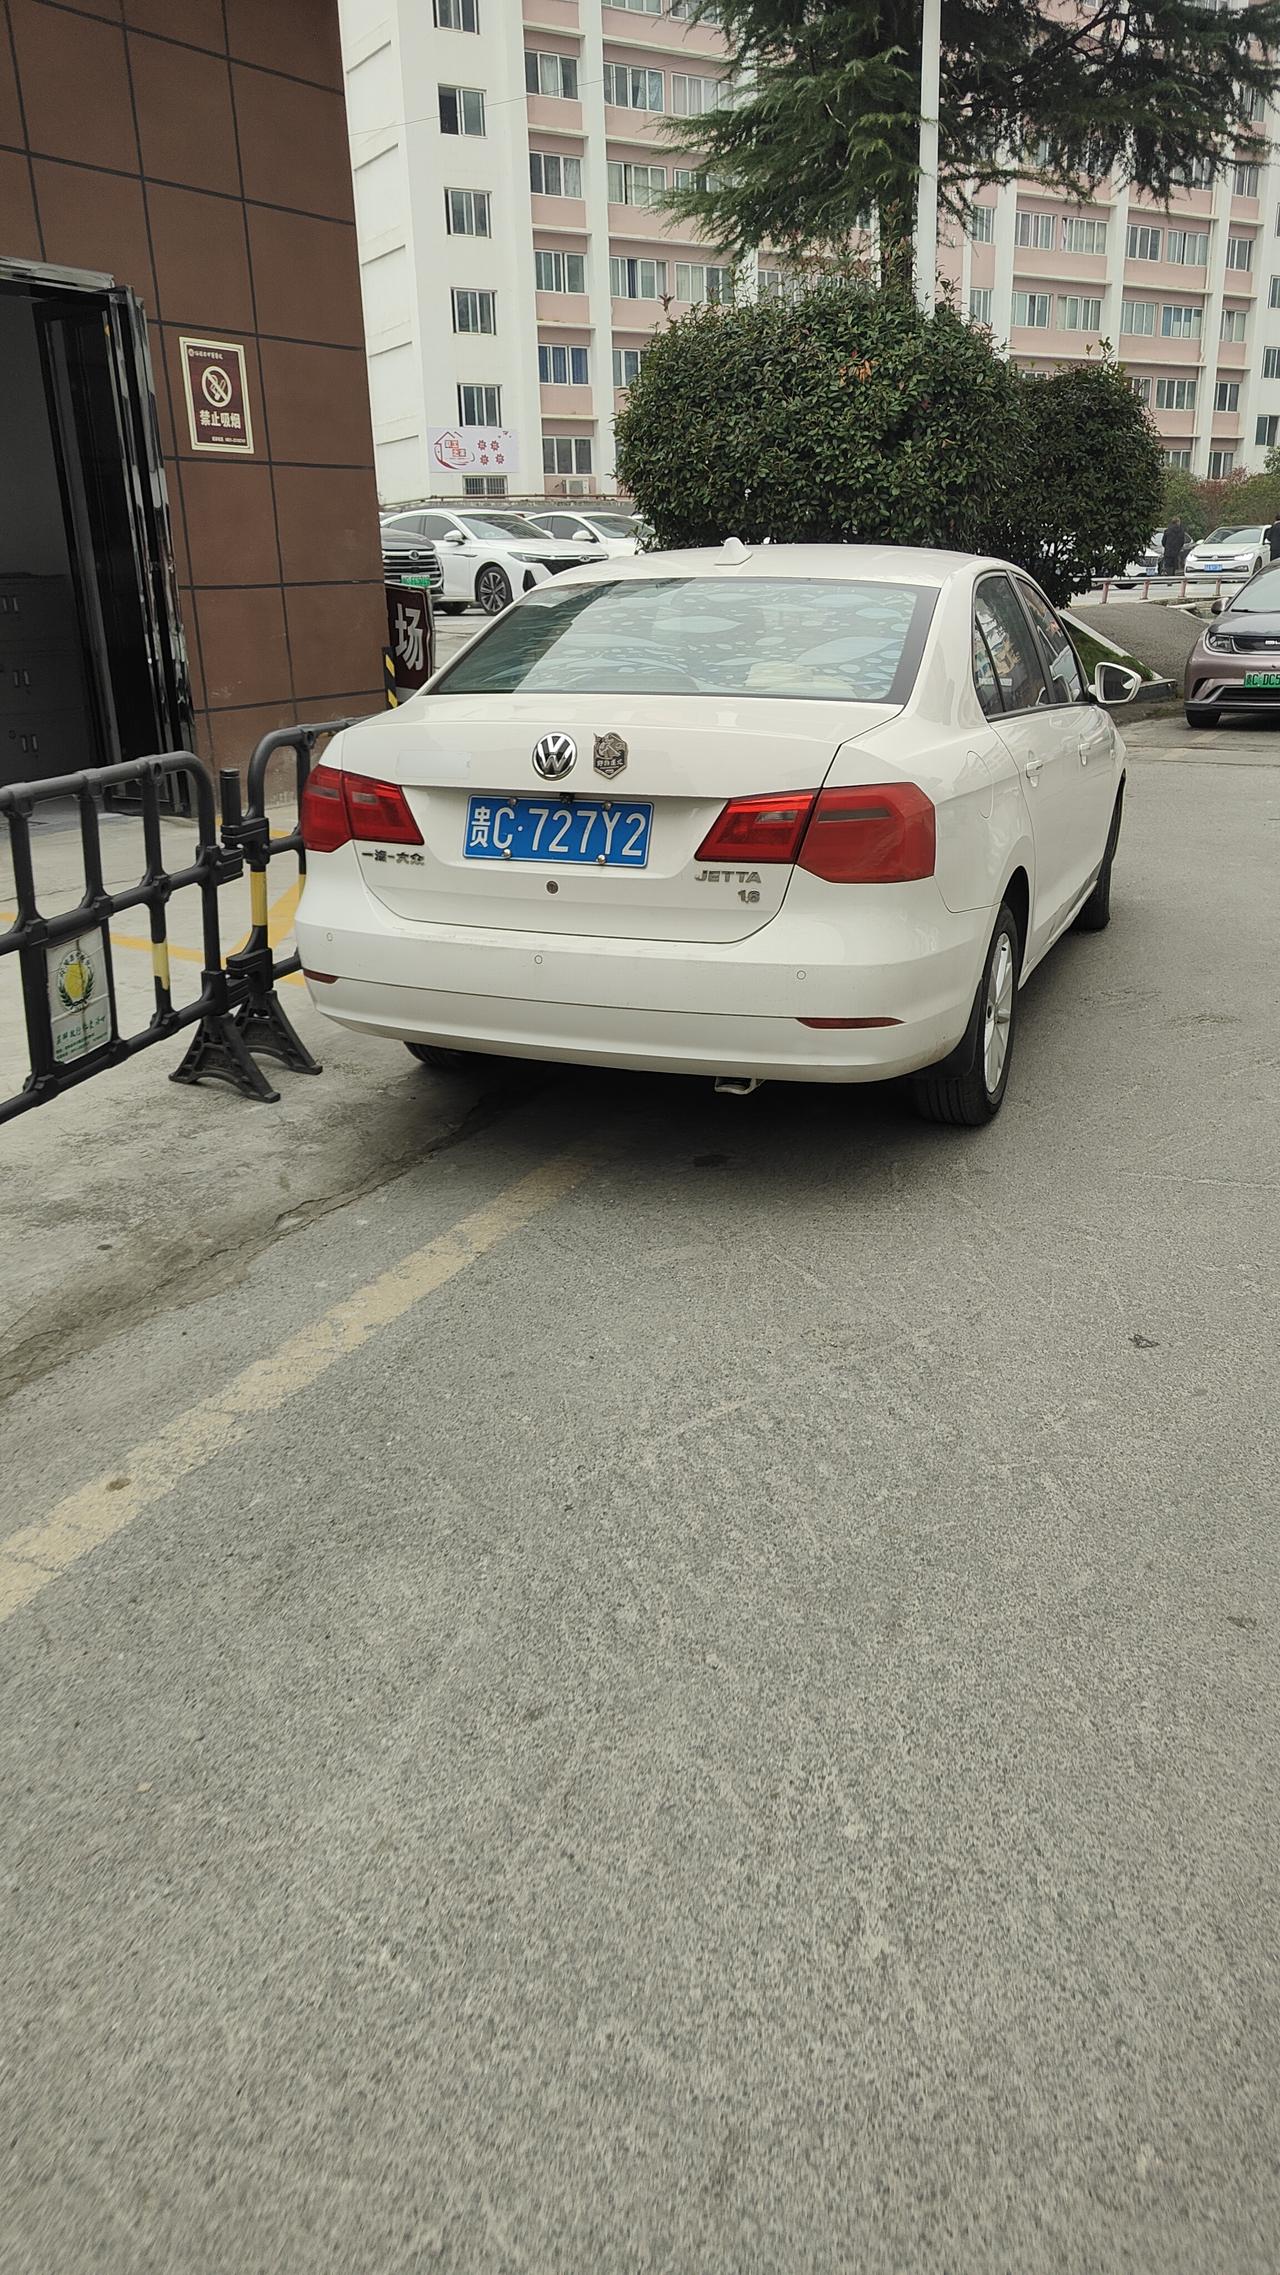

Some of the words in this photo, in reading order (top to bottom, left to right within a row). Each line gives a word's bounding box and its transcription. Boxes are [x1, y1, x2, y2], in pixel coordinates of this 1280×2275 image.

[199, 410, 241, 429] 禁止吸烟
[395, 603, 423, 671] 场
[469, 806, 647, 856] 贵C·727Y2
[695, 870, 761, 883] JETTA
